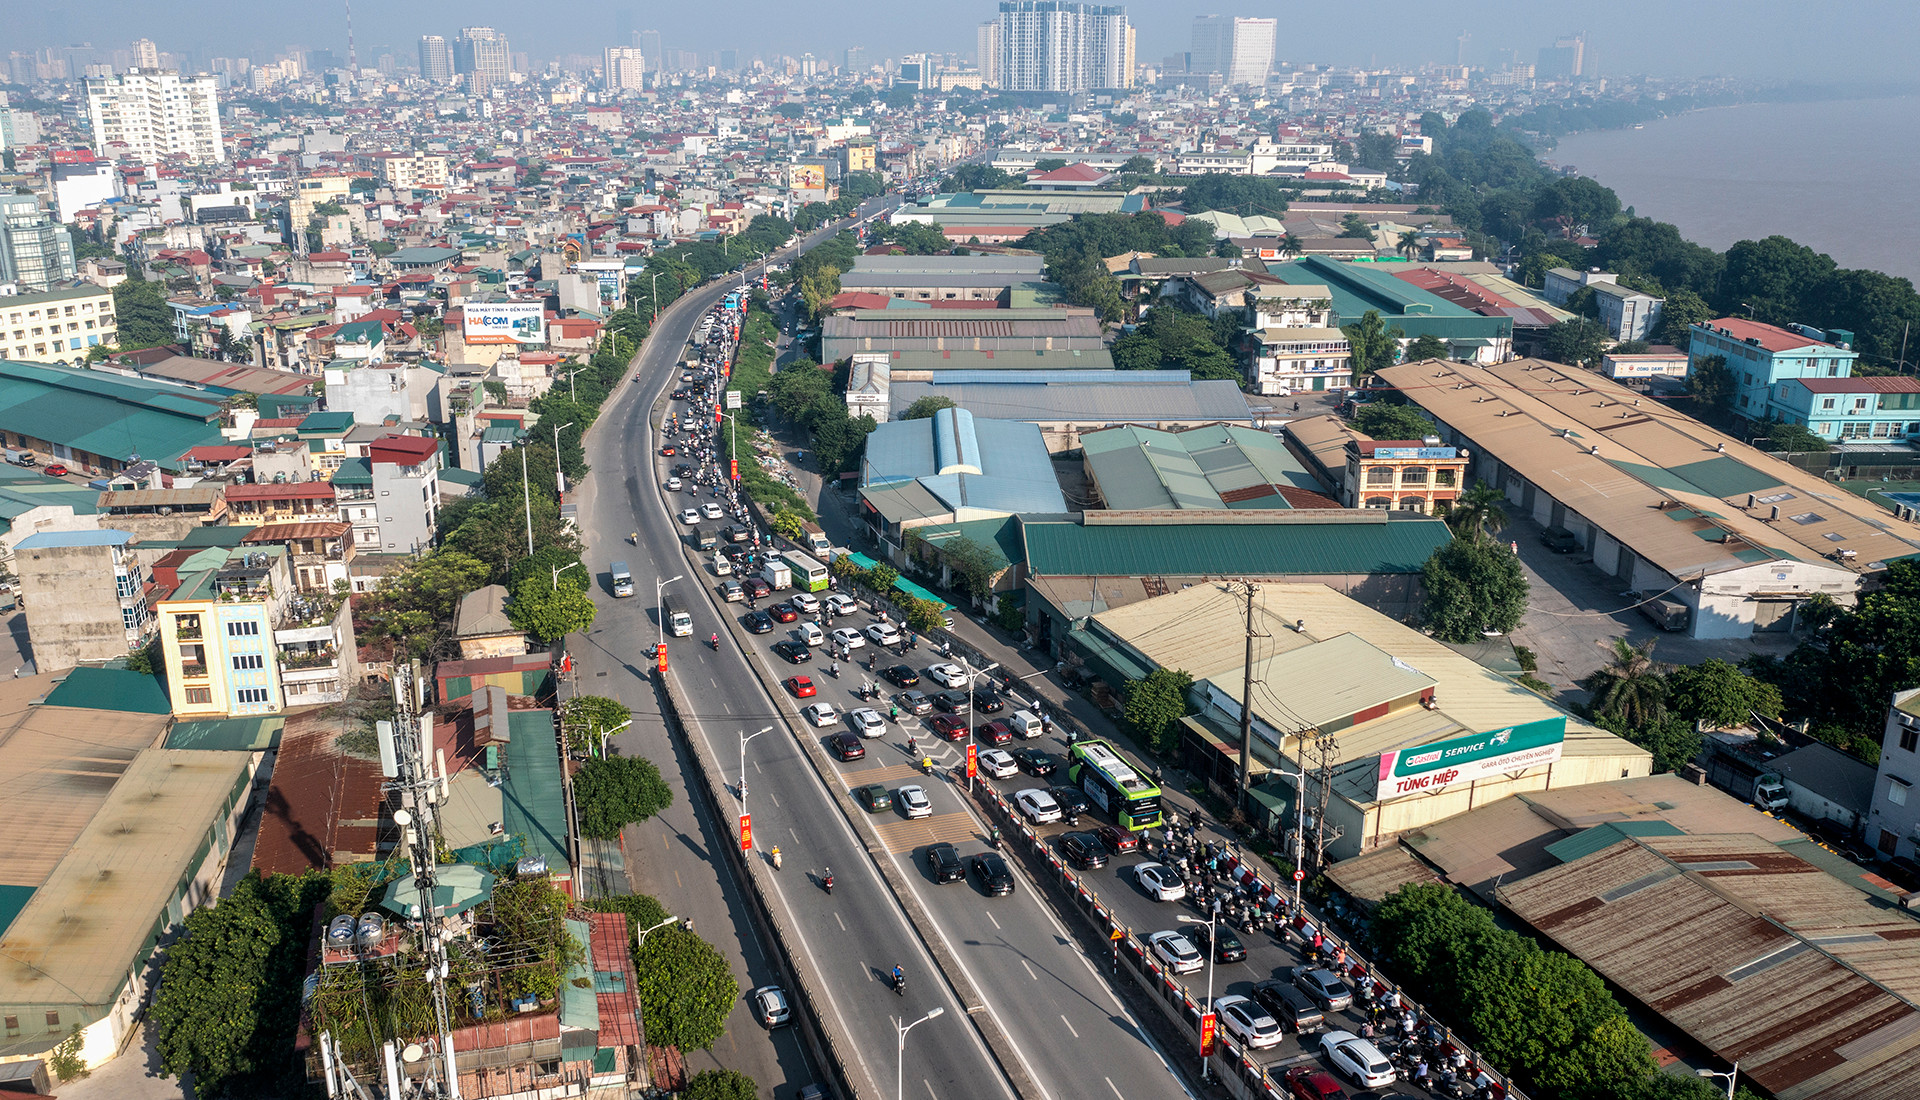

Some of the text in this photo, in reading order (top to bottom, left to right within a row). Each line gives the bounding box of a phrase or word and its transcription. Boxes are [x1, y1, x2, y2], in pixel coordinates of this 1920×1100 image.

[1414, 742, 1485, 764] Castrol SERVICE
[1481, 761, 1498, 770] GARA
[1511, 752, 1534, 763] CHUYÊN
[1534, 747, 1555, 759] NGHIỆP
[1396, 768, 1459, 793] TÙNG HIỆP
